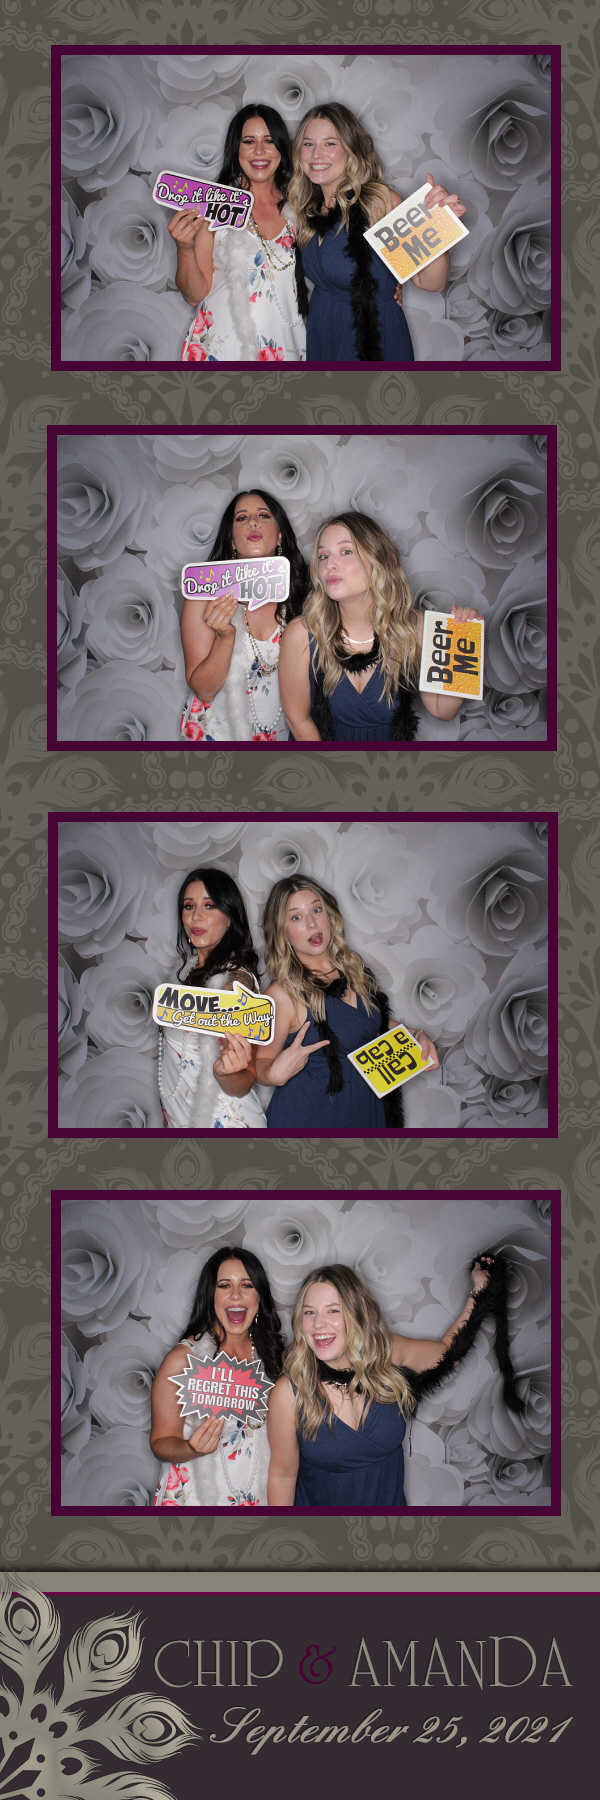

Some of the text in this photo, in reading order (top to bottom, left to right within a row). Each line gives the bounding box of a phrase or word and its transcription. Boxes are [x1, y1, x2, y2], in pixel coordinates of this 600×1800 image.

[157, 183, 251, 207] Drop it like it's
[204, 202, 246, 226] HOT
[373, 201, 433, 253] Beer
[401, 227, 442, 266] Me
[184, 559, 287, 595] Drop it like it's
[240, 574, 283, 600] HOT
[426, 621, 453, 684] Beer
[453, 638, 479, 676] Me
[158, 986, 240, 1013] MOVE...
[172, 1010, 197, 1027] Get
[197, 1014, 218, 1027] out
[219, 1012, 240, 1026] the
[393, 1031, 410, 1045] a
[376, 1051, 418, 1085] Call
[211, 1366, 235, 1383] I'LL
[187, 1377, 260, 1400] REGRET THIS
[191, 1392, 256, 1411] TOMORROW
